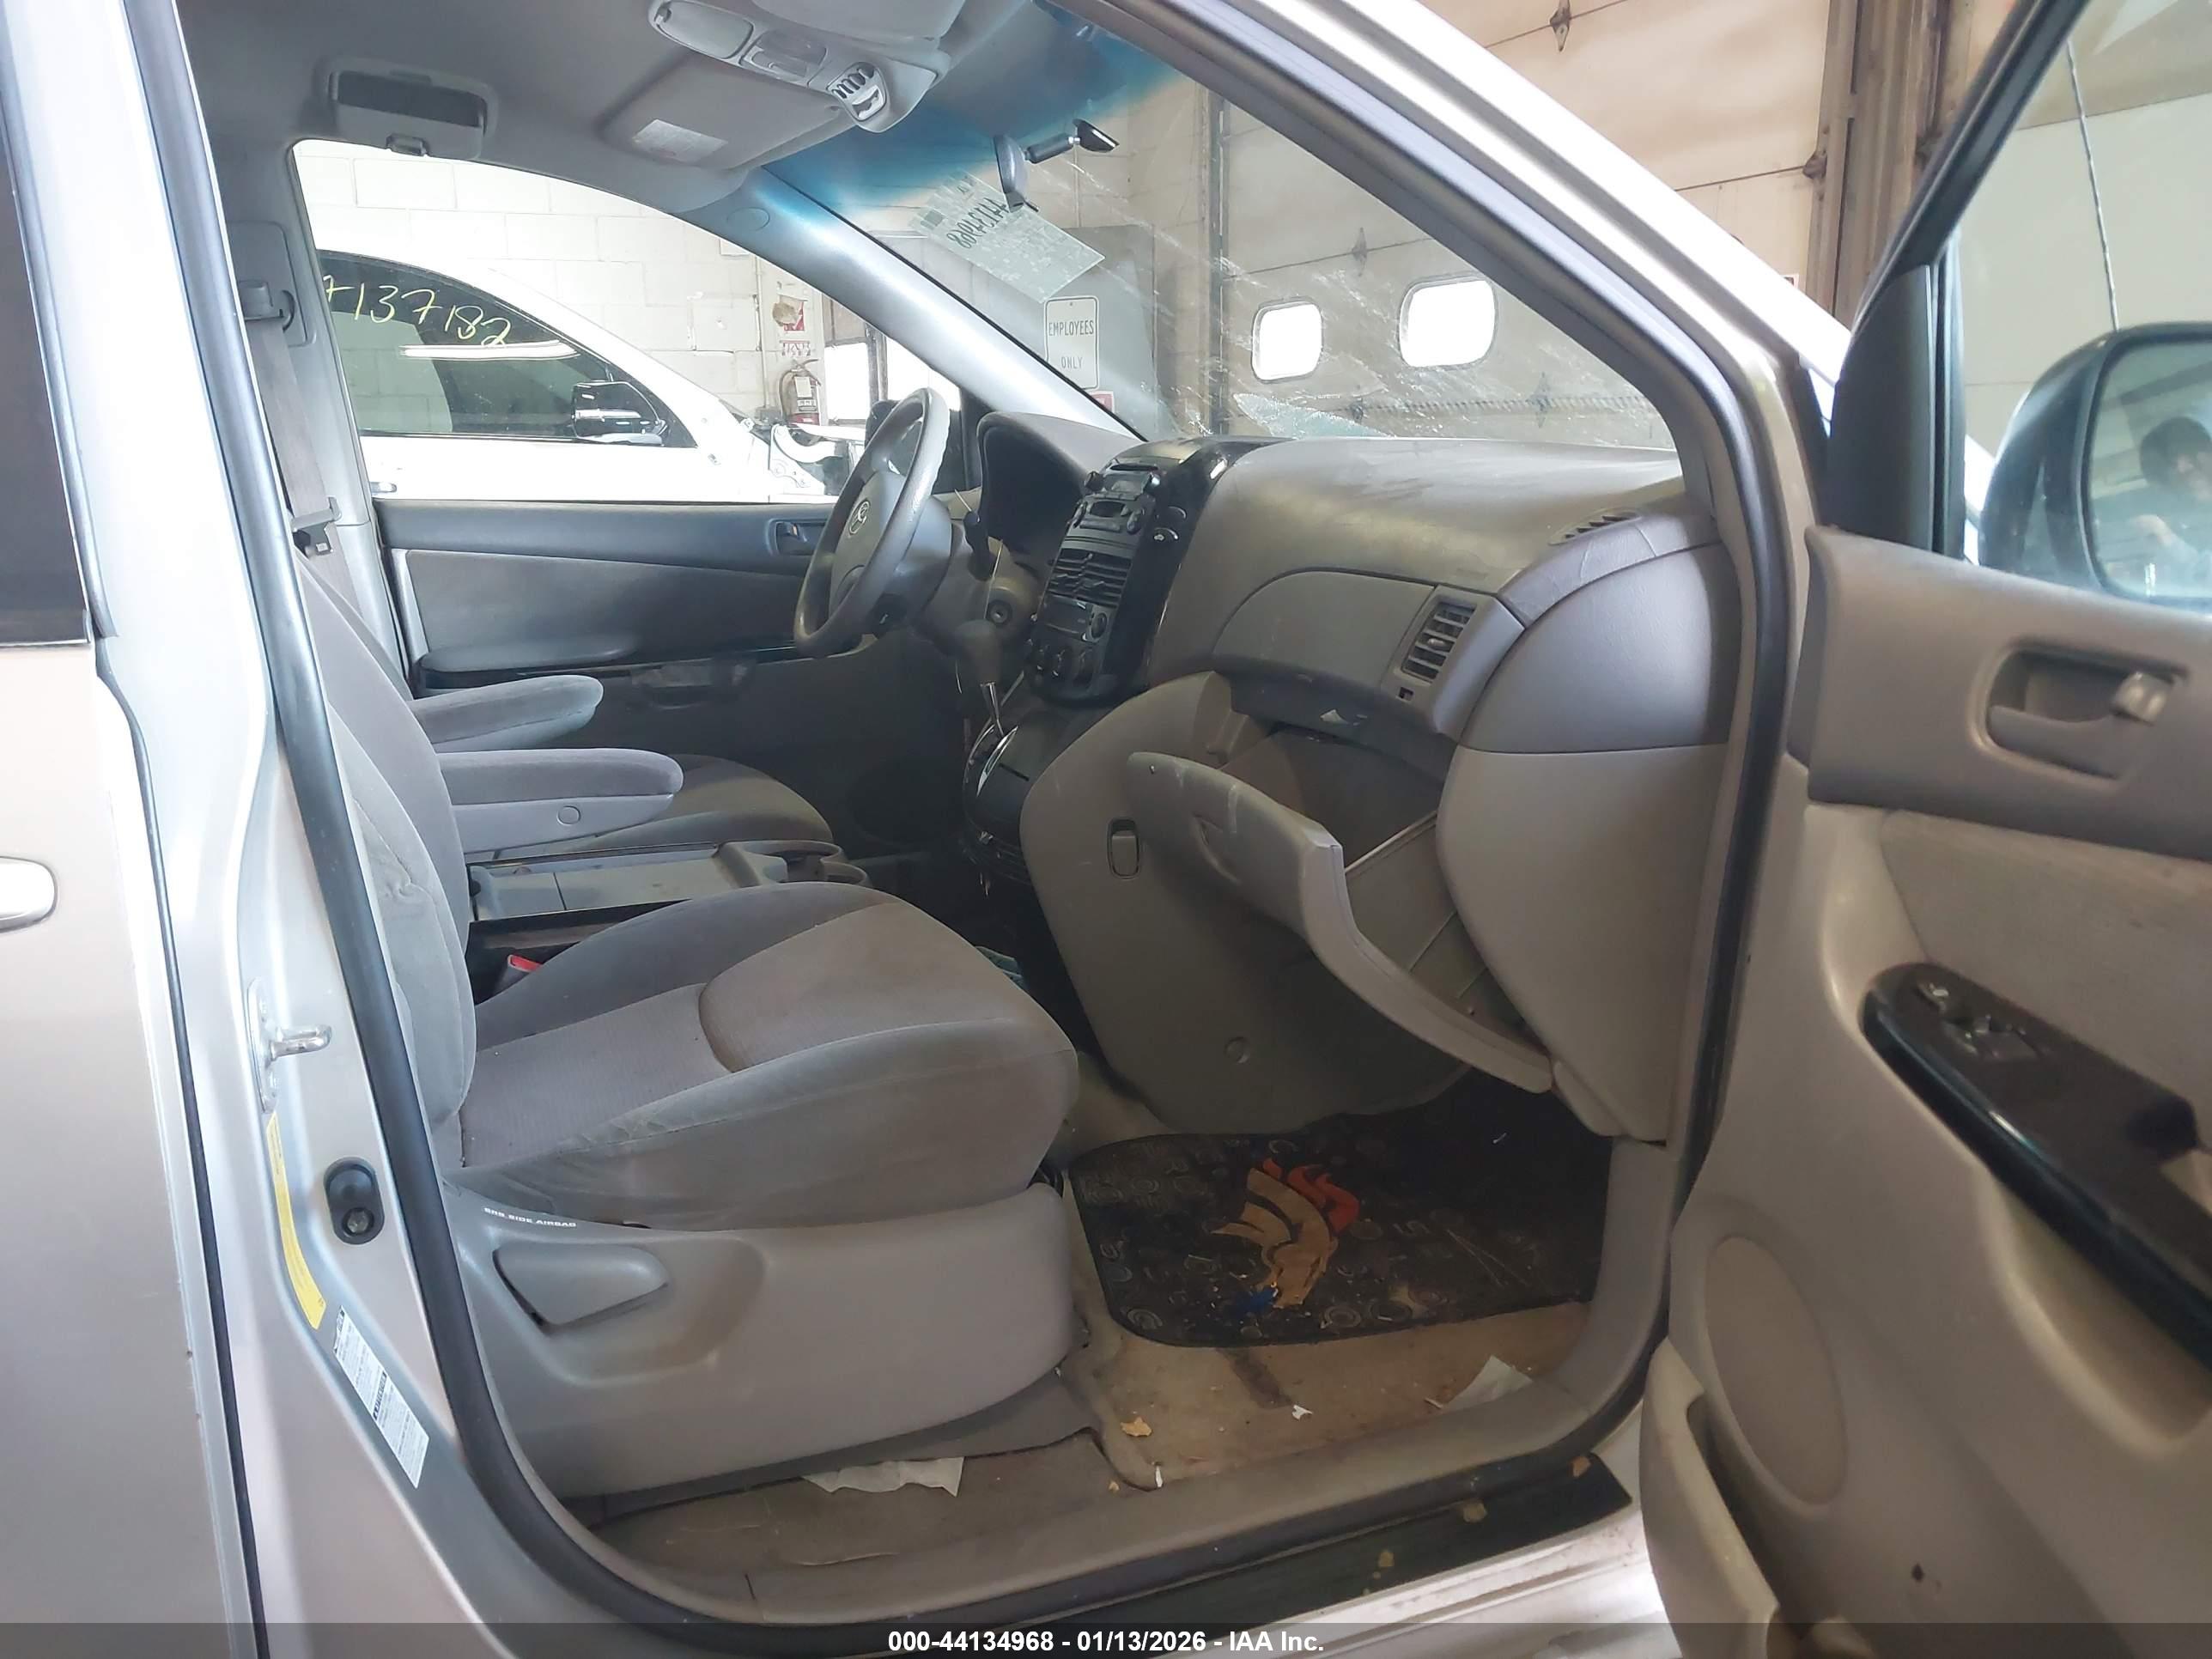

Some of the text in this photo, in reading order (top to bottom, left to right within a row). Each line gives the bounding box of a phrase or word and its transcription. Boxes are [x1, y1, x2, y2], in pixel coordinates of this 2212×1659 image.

[1048, 320, 1094, 337] EMPLOYEES
[1060, 356, 1083, 369] ONLY
[507, 1213, 532, 1224] SIDE
